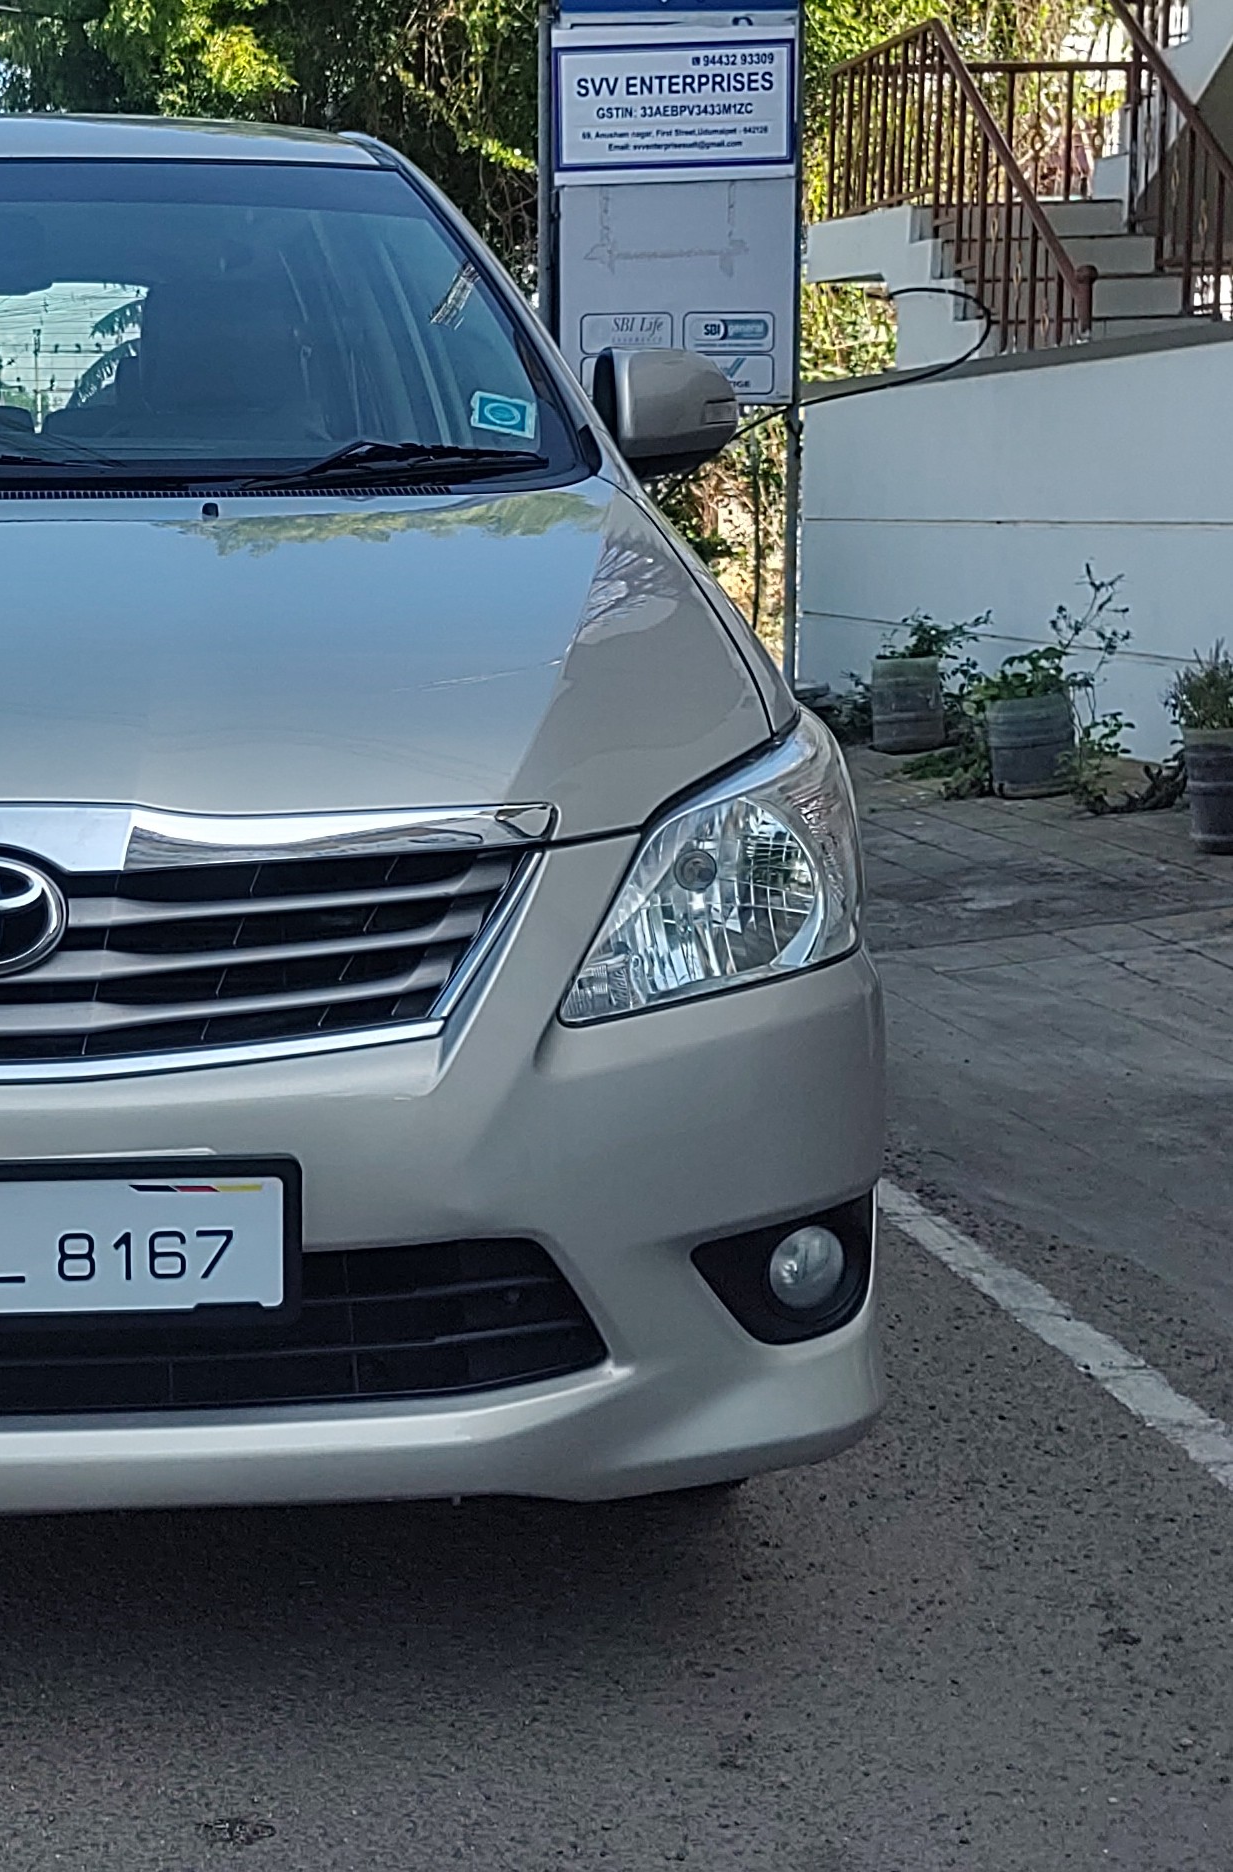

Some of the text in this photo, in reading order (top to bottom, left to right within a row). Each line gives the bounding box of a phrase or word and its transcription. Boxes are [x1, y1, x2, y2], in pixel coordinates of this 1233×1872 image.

[703, 52, 774, 66] 94432 93309
[576, 71, 774, 97] SVV ENTERPRISES
[596, 103, 754, 120] GSTIN: 33AEBPV3433M1ZC
[655, 129, 673, 137] First
[612, 316, 664, 338] SBI Life
[703, 323, 721, 336] SBI
[56, 1228, 236, 1282] 8167
